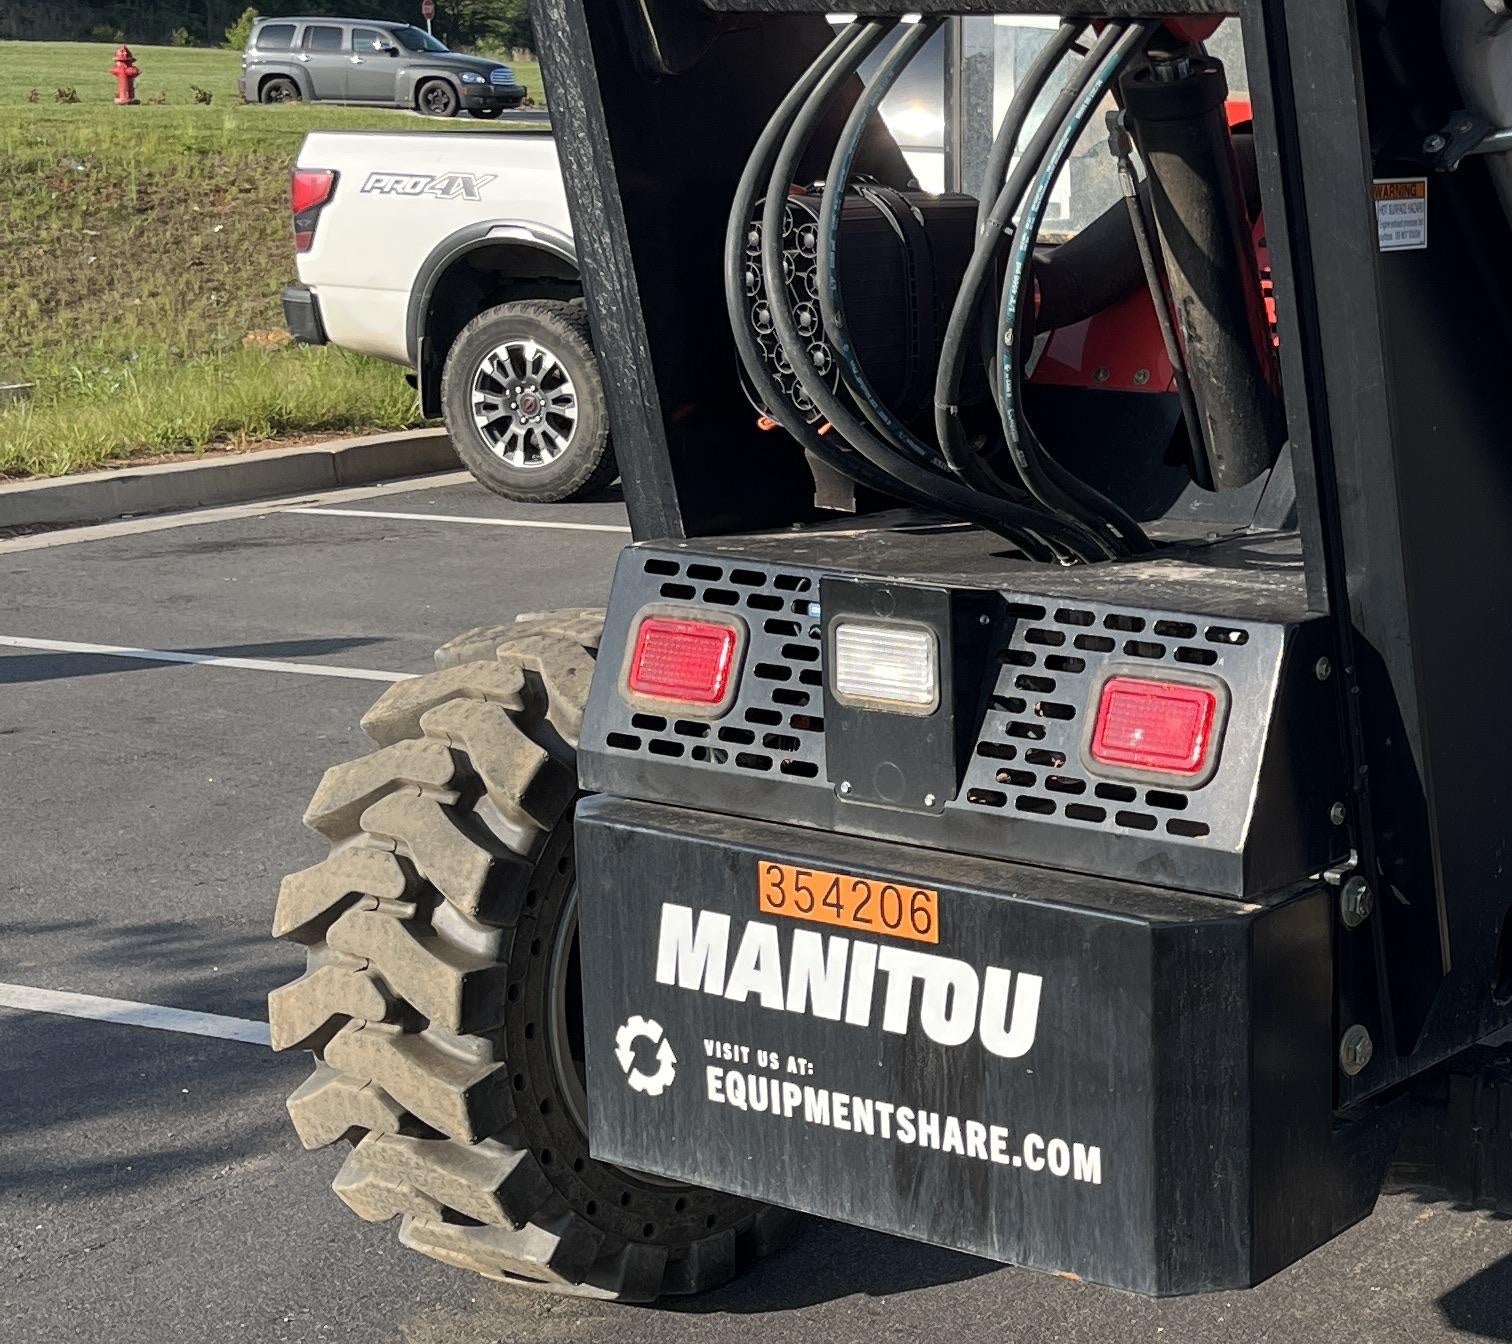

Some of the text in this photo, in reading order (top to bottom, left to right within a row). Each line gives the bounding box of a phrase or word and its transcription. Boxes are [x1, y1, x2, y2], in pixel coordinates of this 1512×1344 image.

[765, 864, 933, 936] 354206
[655, 902, 1043, 1058] MANITOU
[704, 1038, 815, 1075] VISIT US AT:
[706, 1065, 1102, 1185] EQUIPMENTSHARE.COM
